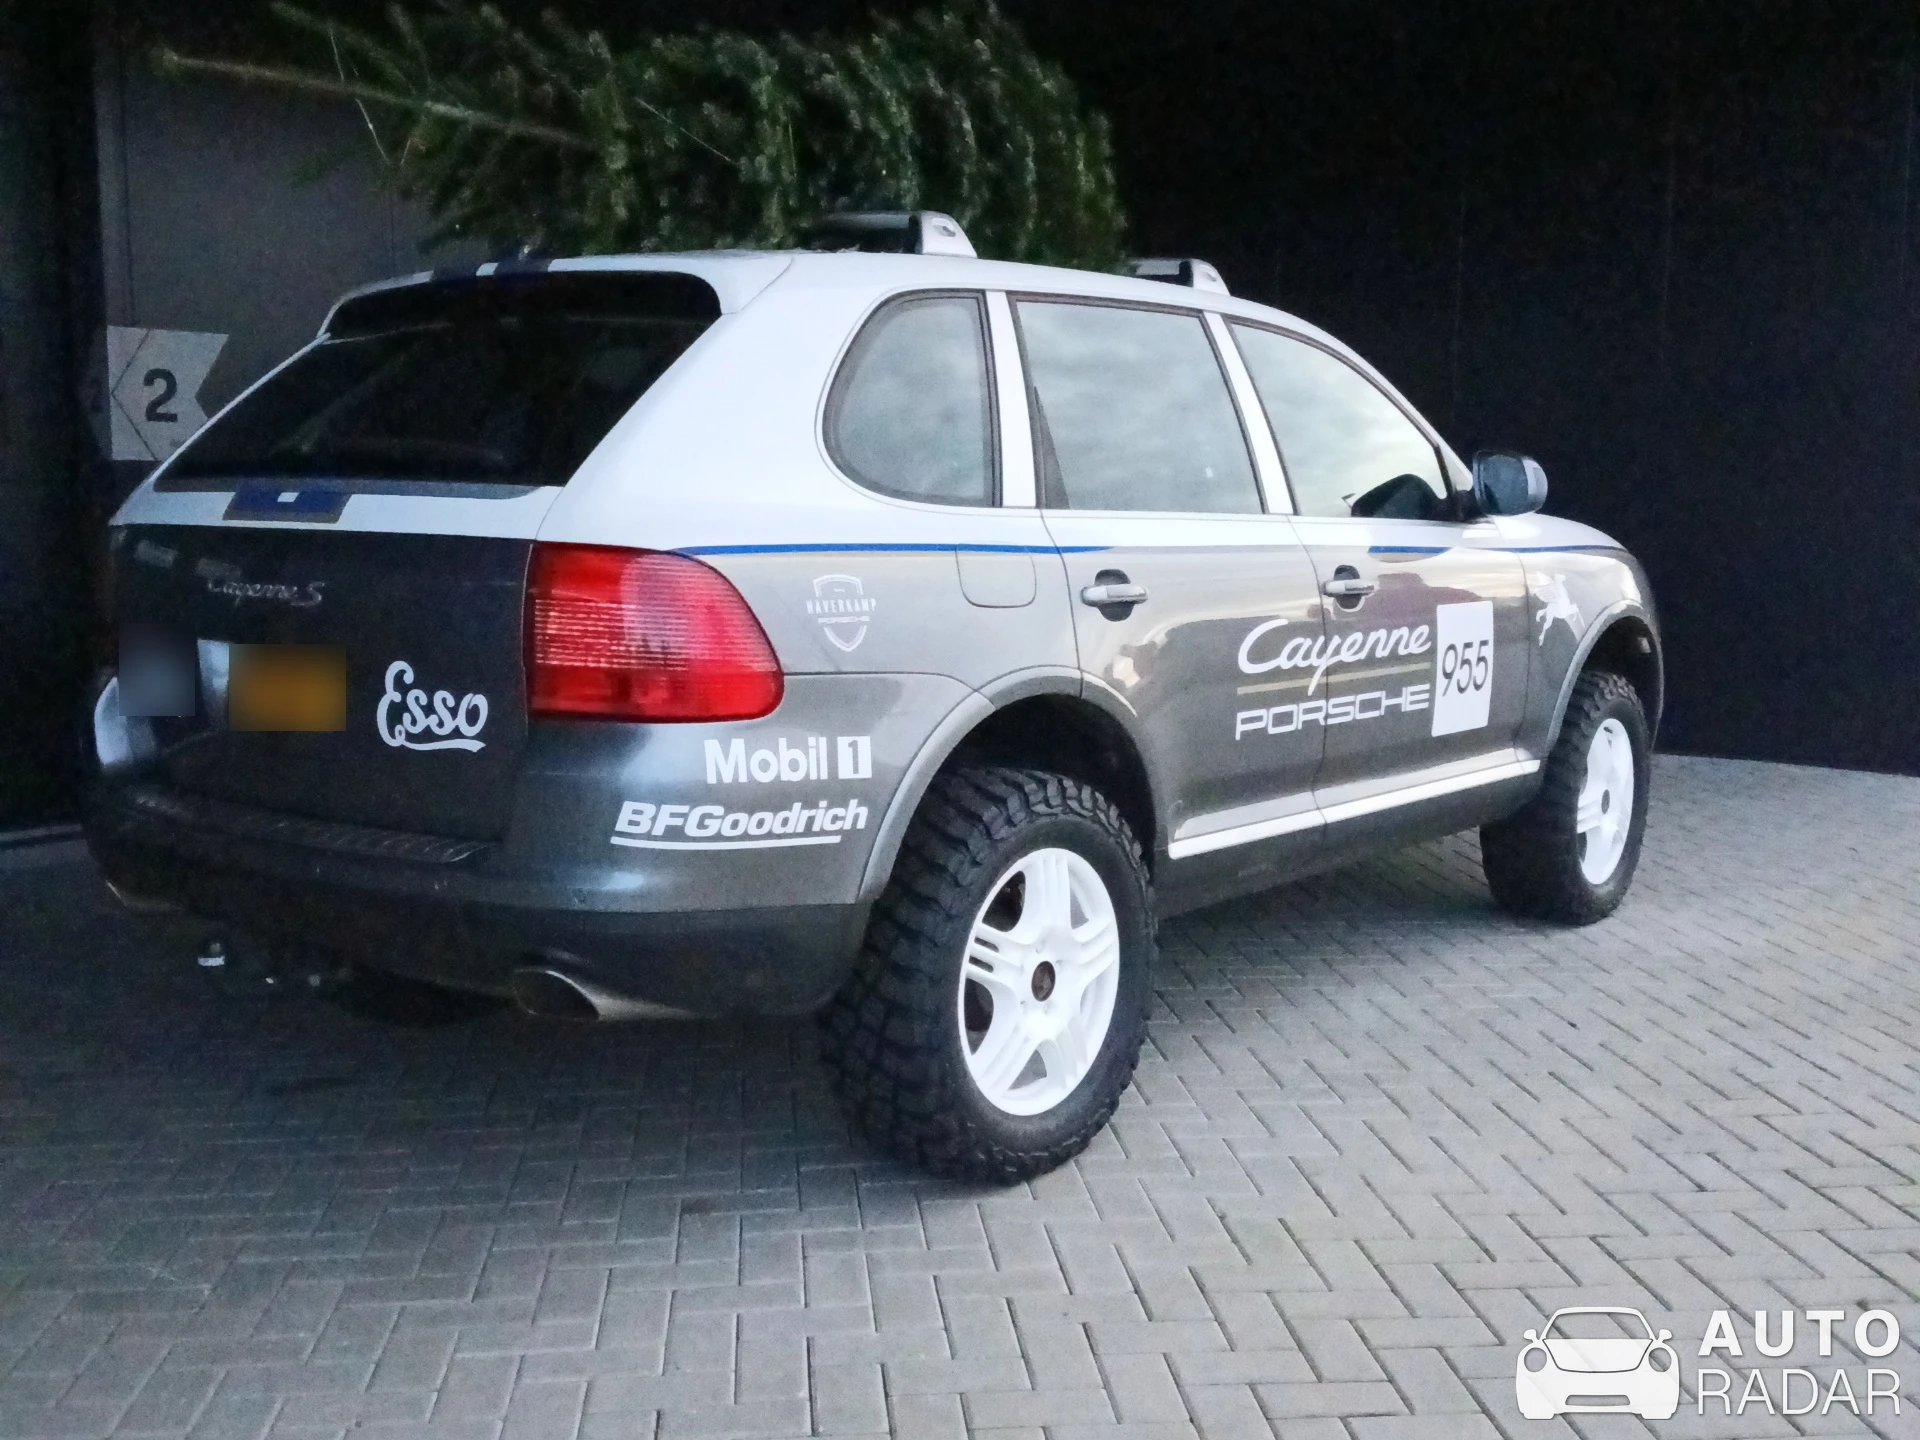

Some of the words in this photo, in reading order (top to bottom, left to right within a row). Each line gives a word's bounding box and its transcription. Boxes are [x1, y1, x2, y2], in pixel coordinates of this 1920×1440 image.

[143, 368, 178, 423] 2
[292, 581, 325, 606] S
[1237, 618, 1432, 696] Cayenne
[1441, 639, 1490, 697] 955
[376, 660, 489, 752] Esso
[1235, 683, 1431, 740] PORSCHE
[703, 737, 828, 784] Mobil
[614, 799, 869, 837] BFGoodrich
